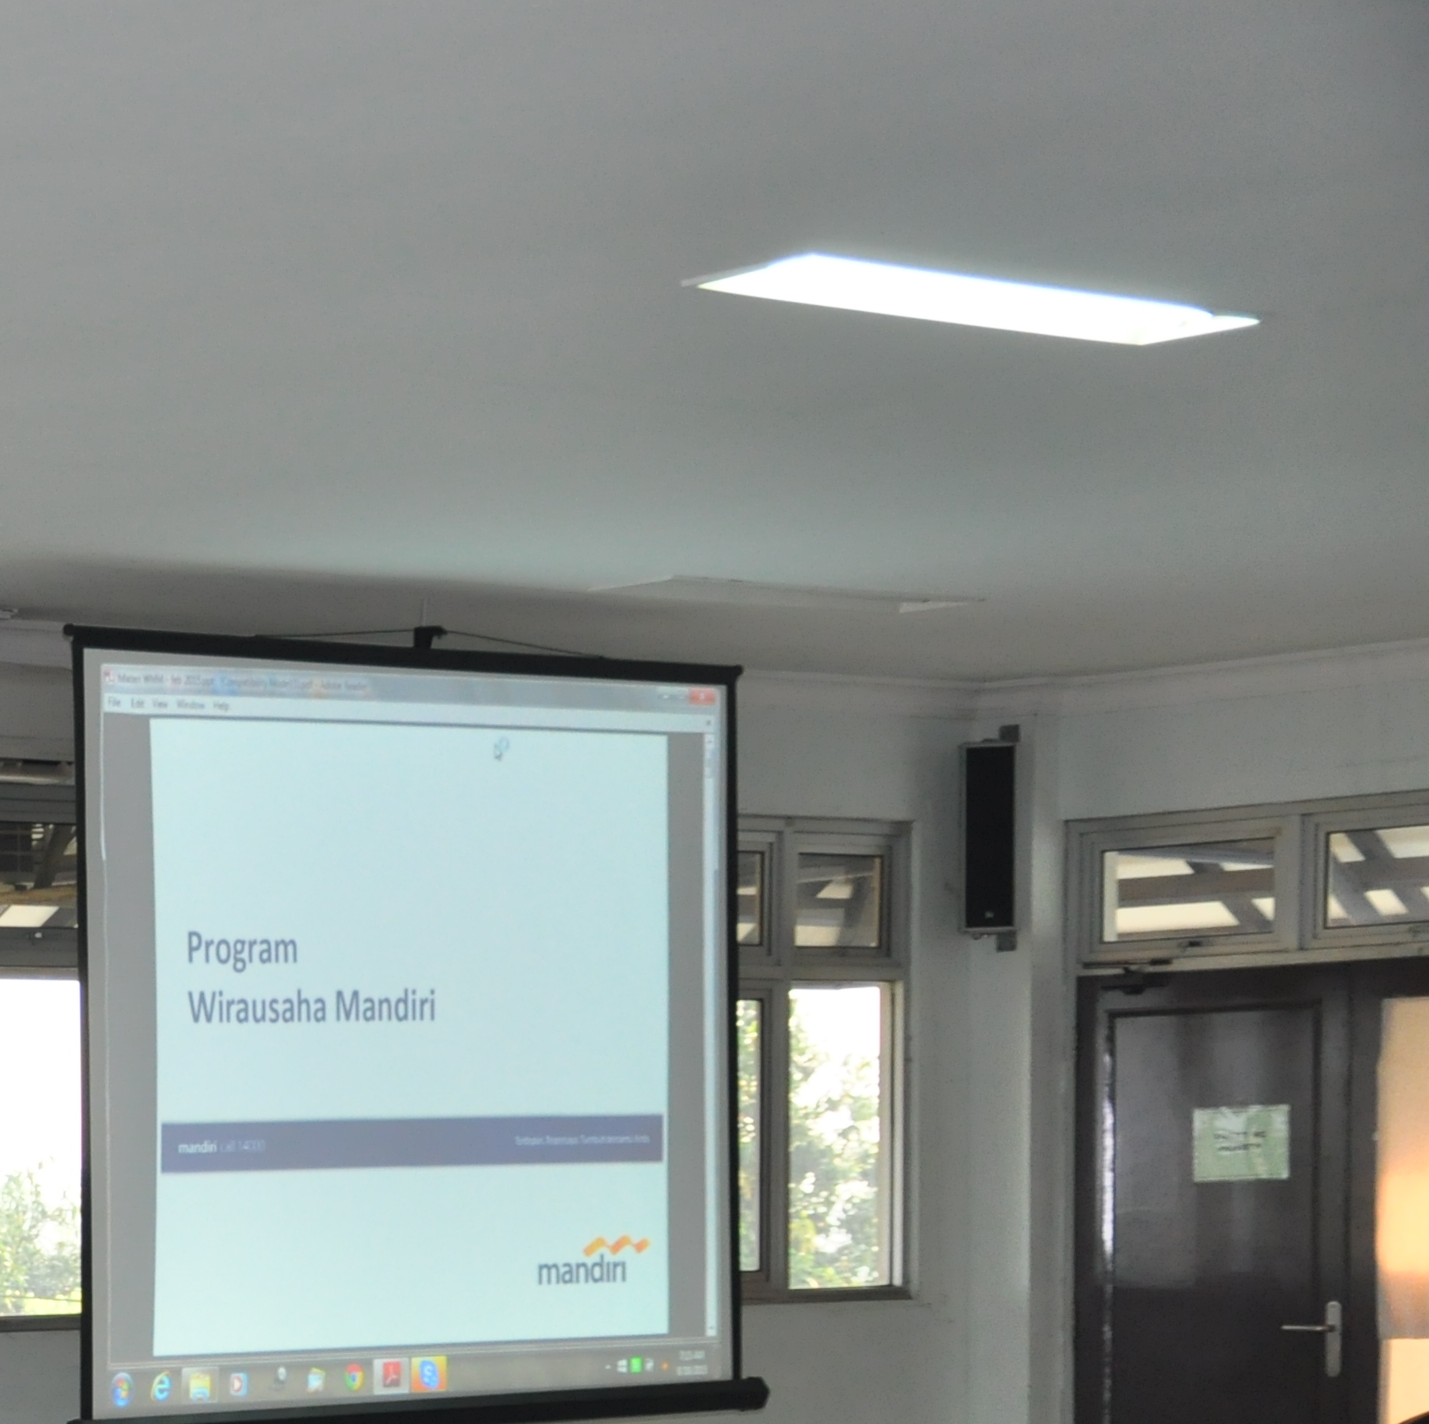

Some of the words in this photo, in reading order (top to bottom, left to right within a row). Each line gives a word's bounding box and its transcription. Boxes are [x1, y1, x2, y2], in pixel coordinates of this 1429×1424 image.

[177, 700, 205, 710] Window
[186, 929, 298, 972] Program
[187, 988, 327, 1024] Wirausaha
[335, 988, 436, 1023] Mandiri
[178, 1140, 217, 1154] mandiri
[538, 1254, 627, 1287] mandiri
